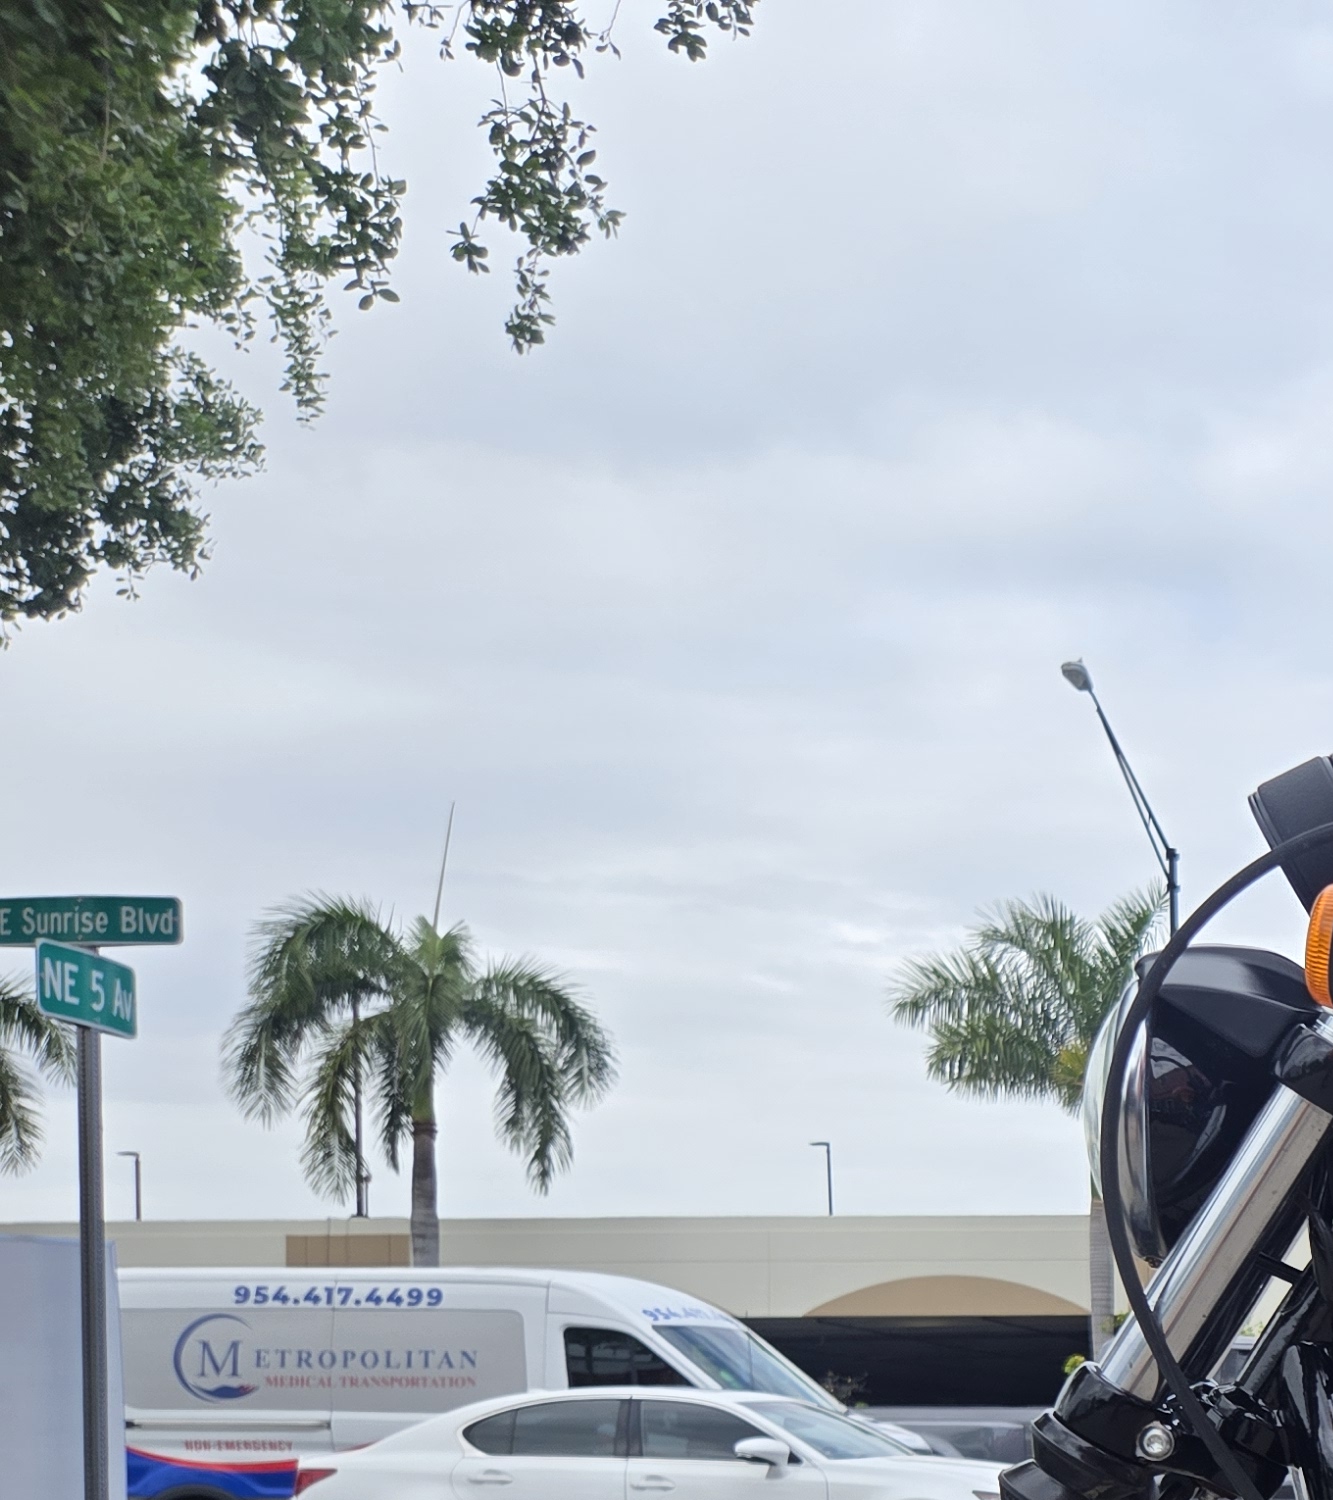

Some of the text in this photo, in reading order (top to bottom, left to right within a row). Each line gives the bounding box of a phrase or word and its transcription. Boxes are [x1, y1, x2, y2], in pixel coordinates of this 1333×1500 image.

[22, 906, 109, 936] Sunrise
[120, 905, 174, 935] Blvd
[43, 956, 80, 1006] NE
[90, 969, 105, 1013] 5
[233, 1285, 444, 1307] 954.417.4499
[196, 1340, 478, 1378] METROPOLITAN
[265, 1376, 334, 1388] MEDICAL
